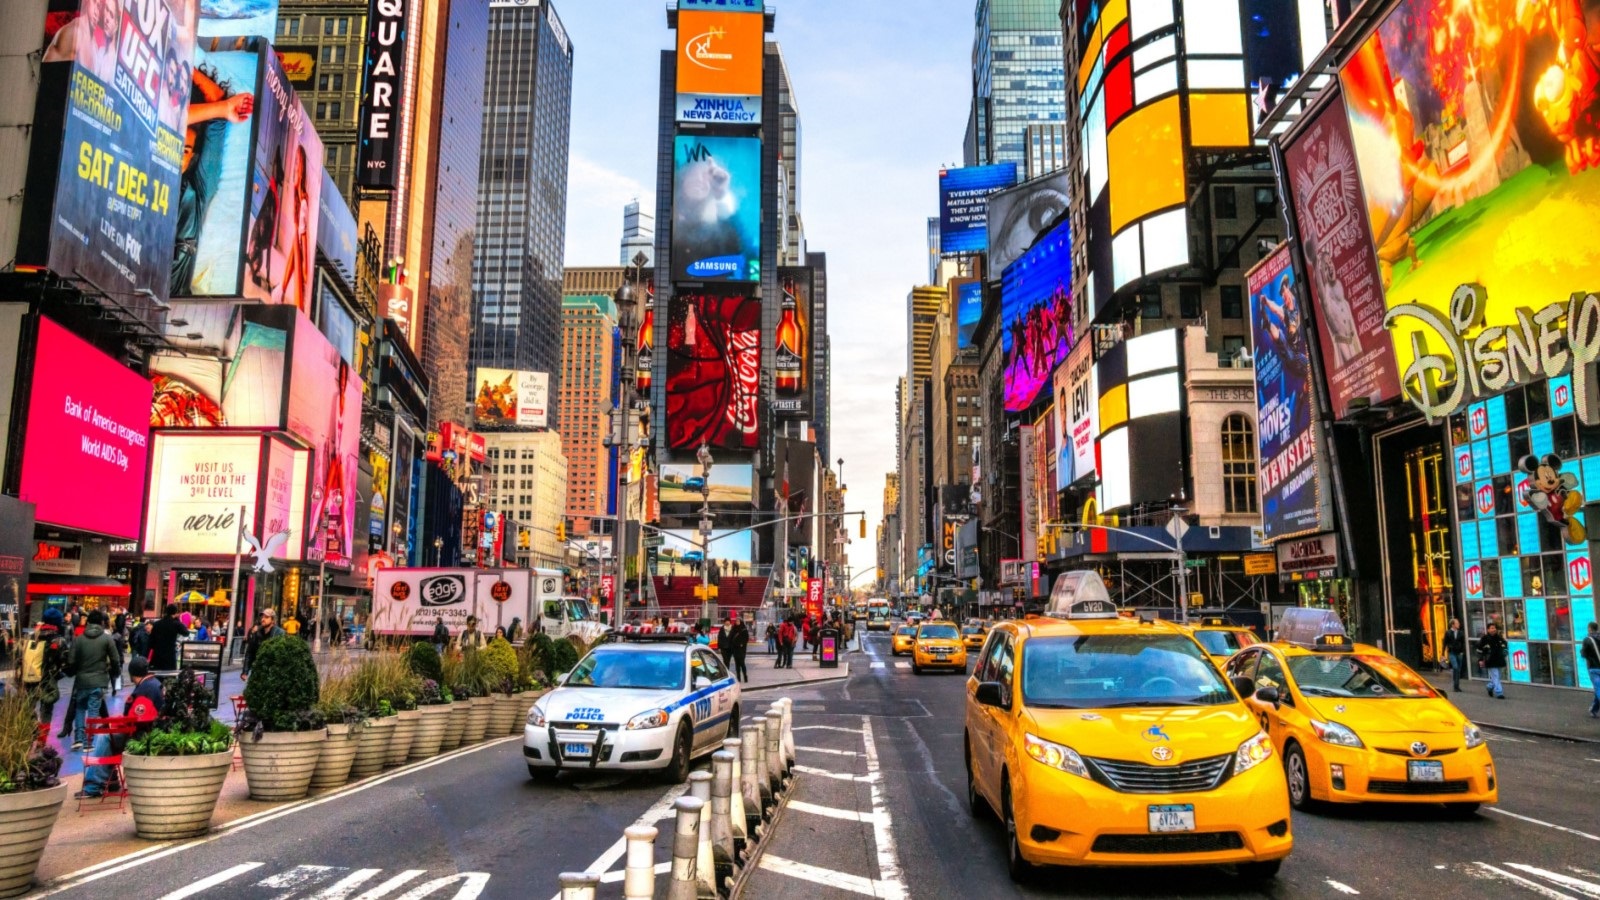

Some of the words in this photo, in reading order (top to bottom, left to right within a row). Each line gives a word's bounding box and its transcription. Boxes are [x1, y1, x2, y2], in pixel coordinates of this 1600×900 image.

[120, 21, 162, 101] UFC
[76, 71, 105, 100] FABER
[116, 64, 158, 129] SATURDAY
[694, 98, 744, 112] XINHUA
[683, 110, 712, 120] NEWS
[714, 111, 755, 121] AGENCY
[366, 160, 386, 169] NYC
[116, 161, 149, 208] DEC.
[151, 179, 169, 216] 14
[947, 199, 974, 207] MATILDA
[950, 215, 970, 223] KNOW
[100, 217, 116, 243] LIVE
[116, 231, 125, 251] ON
[125, 232, 142, 266] FOX
[694, 261, 738, 271] SAMSUNG
[1070, 353, 1090, 388] ZACHARY
[1072, 378, 1089, 424] LEVI
[1210, 389, 1228, 400] THE
[779, 401, 795, 409] TASTE
[65, 395, 82, 419] Bank
[83, 405, 93, 422] of
[92, 409, 117, 435] America
[117, 424, 146, 447] recognizes
[1259, 397, 1291, 448] MOVES
[81, 434, 101, 458] World
[101, 443, 117, 464] AIDS
[194, 462, 218, 473] VISIT
[221, 462, 234, 473] US
[180, 475, 211, 485] INSIDE
[214, 475, 227, 486] ON
[230, 475, 247, 486] THE
[207, 487, 234, 498] LEVEL
[182, 507, 235, 532] aerie
[1320, 569, 1334, 577] SONY
[1569, 556, 1593, 591] IN
[428, 582, 457, 597] edge
[811, 581, 821, 601] tkts
[432, 609, 467, 617] 947-3343
[565, 713, 605, 721] POLICE
